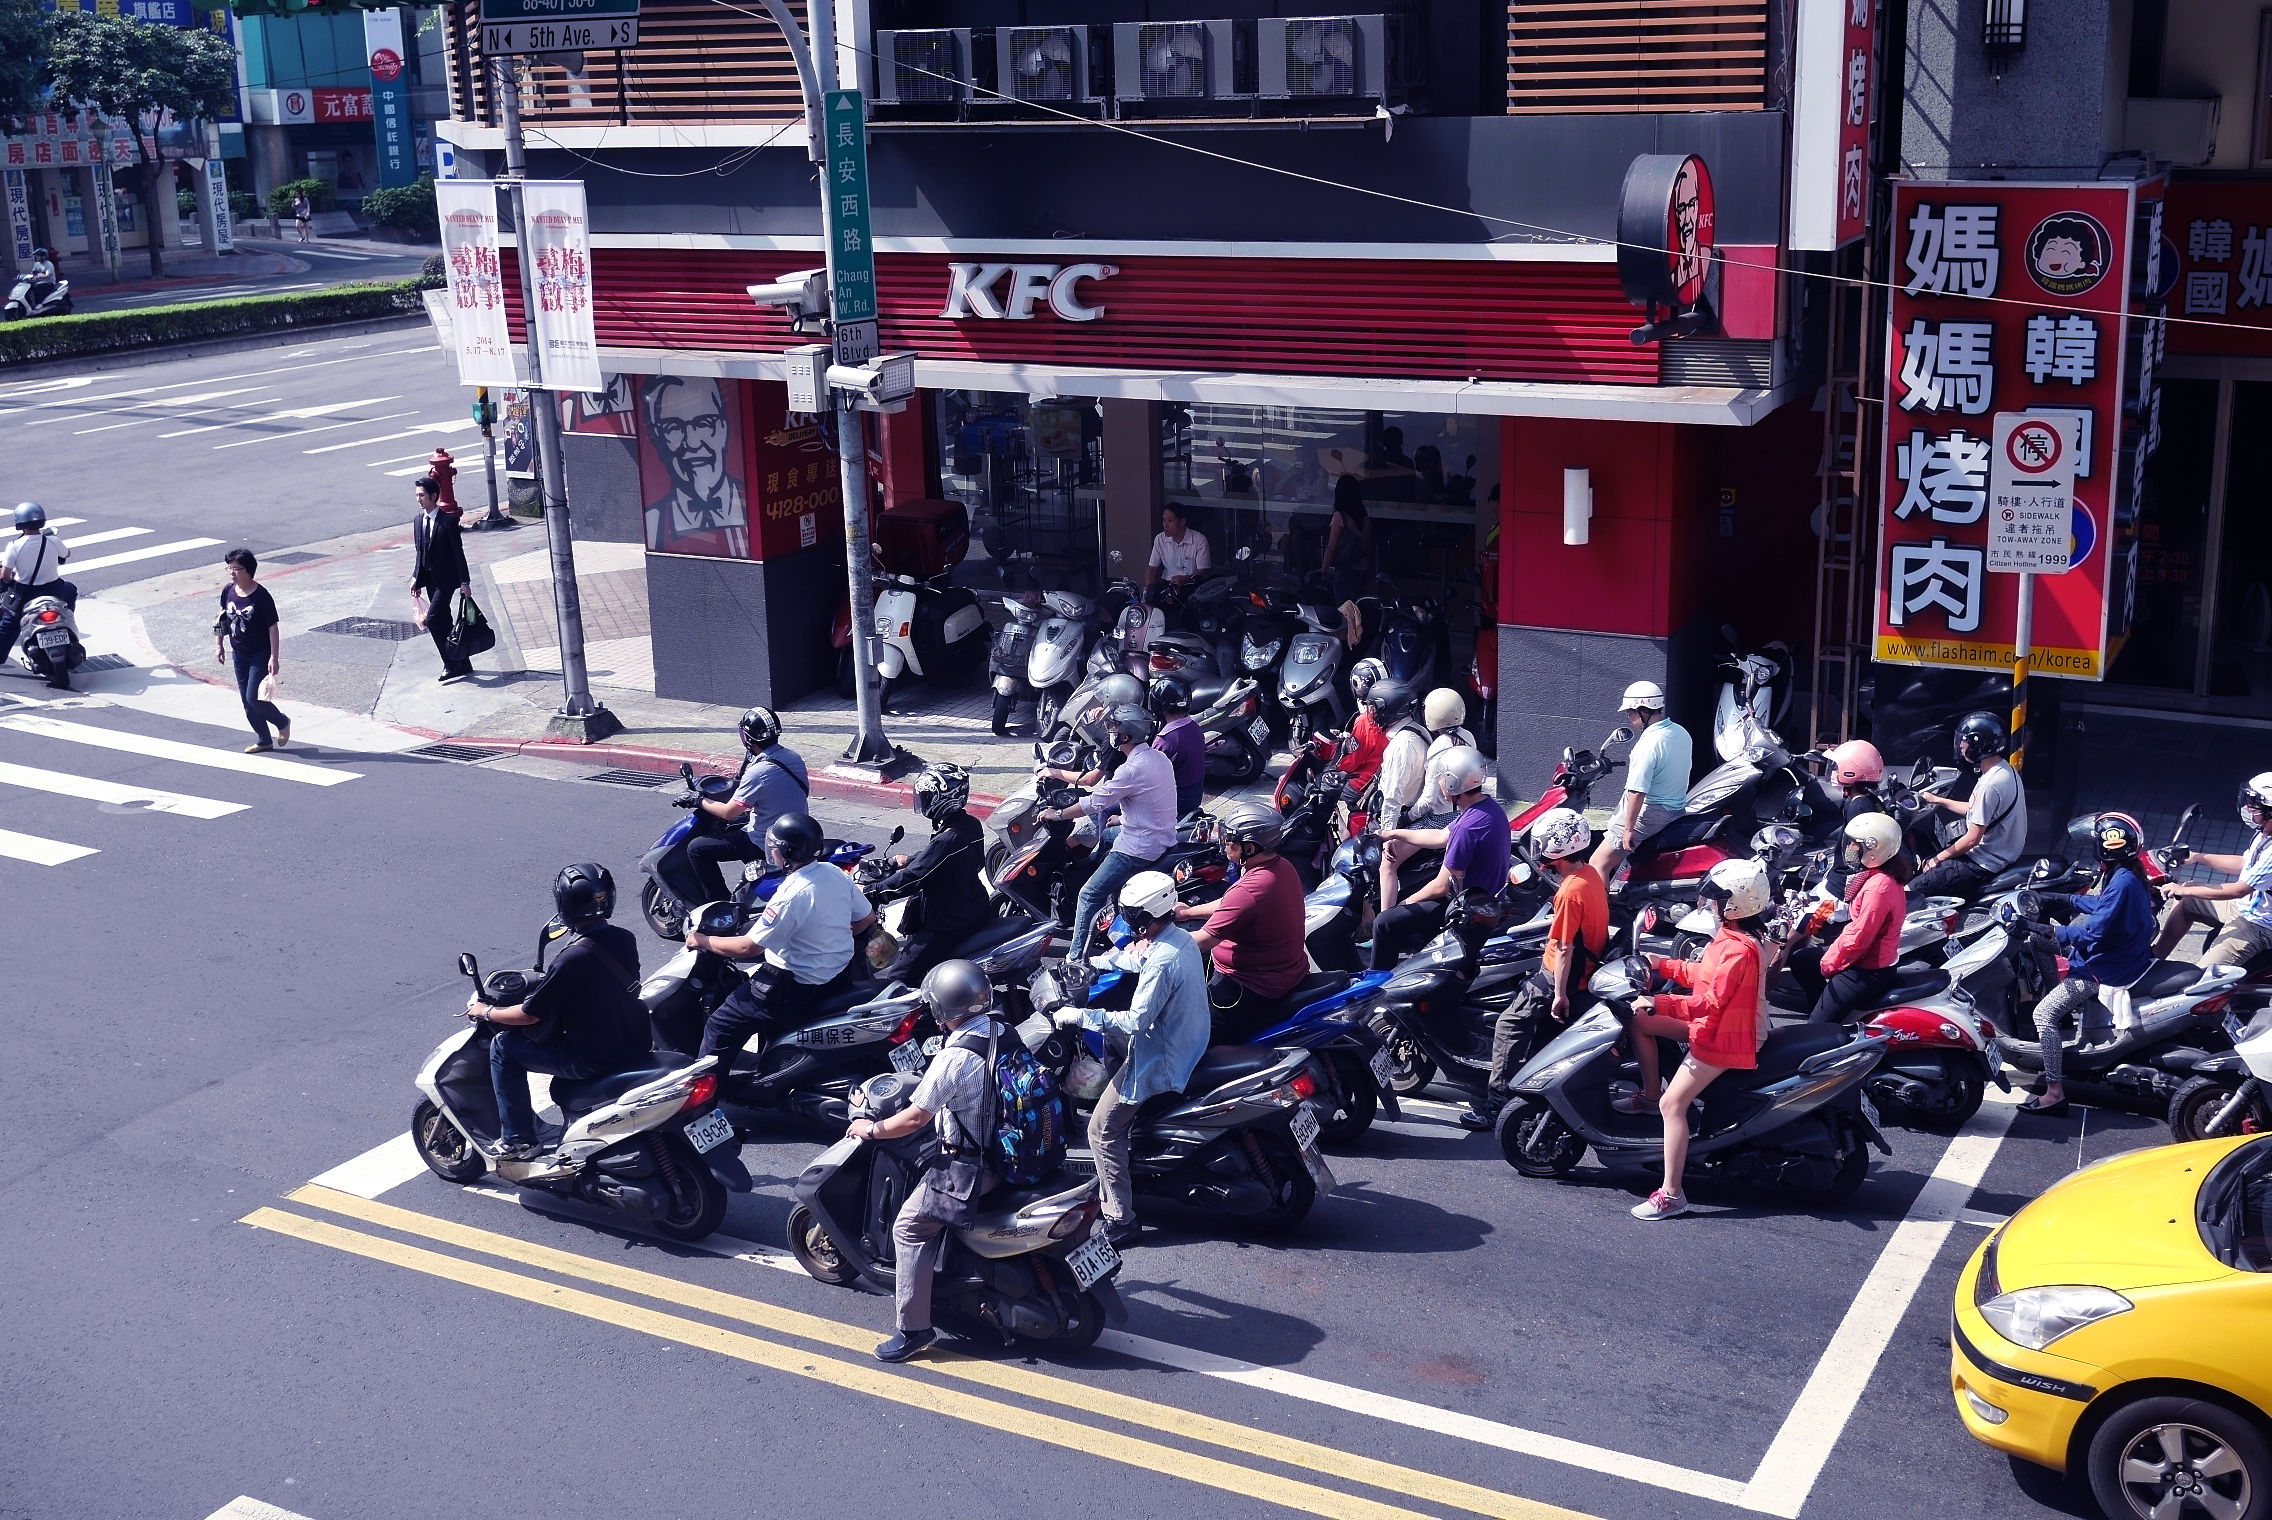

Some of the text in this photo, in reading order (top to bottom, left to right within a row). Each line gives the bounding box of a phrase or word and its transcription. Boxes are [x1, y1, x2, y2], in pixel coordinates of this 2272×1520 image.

[133, 2, 176, 20] 旗艦店
[489, 22, 630, 51] N 5th Ave. S
[382, 91, 400, 170] 中國信託銀行
[836, 122, 862, 253] 長安西路
[211, 181, 230, 245] 現代房屋
[445, 215, 465, 223] WANTED
[531, 215, 553, 224] WANTED
[1698, 212, 1714, 228] KFC
[9, 188, 32, 259] 現代房屋
[2185, 219, 2233, 315] 韓國
[837, 270, 869, 284] Chang
[839, 286, 852, 299] An
[939, 262, 1106, 321] KFC
[839, 299, 870, 314] W. Rd.
[476, 337, 492, 345] 2014
[841, 327, 862, 343] 6th
[842, 344, 873, 361] Blvd.
[1887, 203, 1999, 632] 媽媽烤肉
[788, 427, 816, 441] DELIVERY
[2020, 433, 2048, 462] 停
[766, 457, 837, 494] 現食專送
[766, 486, 839, 520] 4128-000
[2019, 512, 2060, 520] SIDEWALK
[2005, 523, 2055, 535] 違者拖吊
[1997, 536, 2062, 545] TOW-AWAY ZONE
[1990, 550, 2067, 565] 市民熱線 1999
[796, 1028, 856, 1045] 中興保全
[692, 1118, 729, 1149] 219-CHP
[2020, 1376, 2066, 1392] WISH
